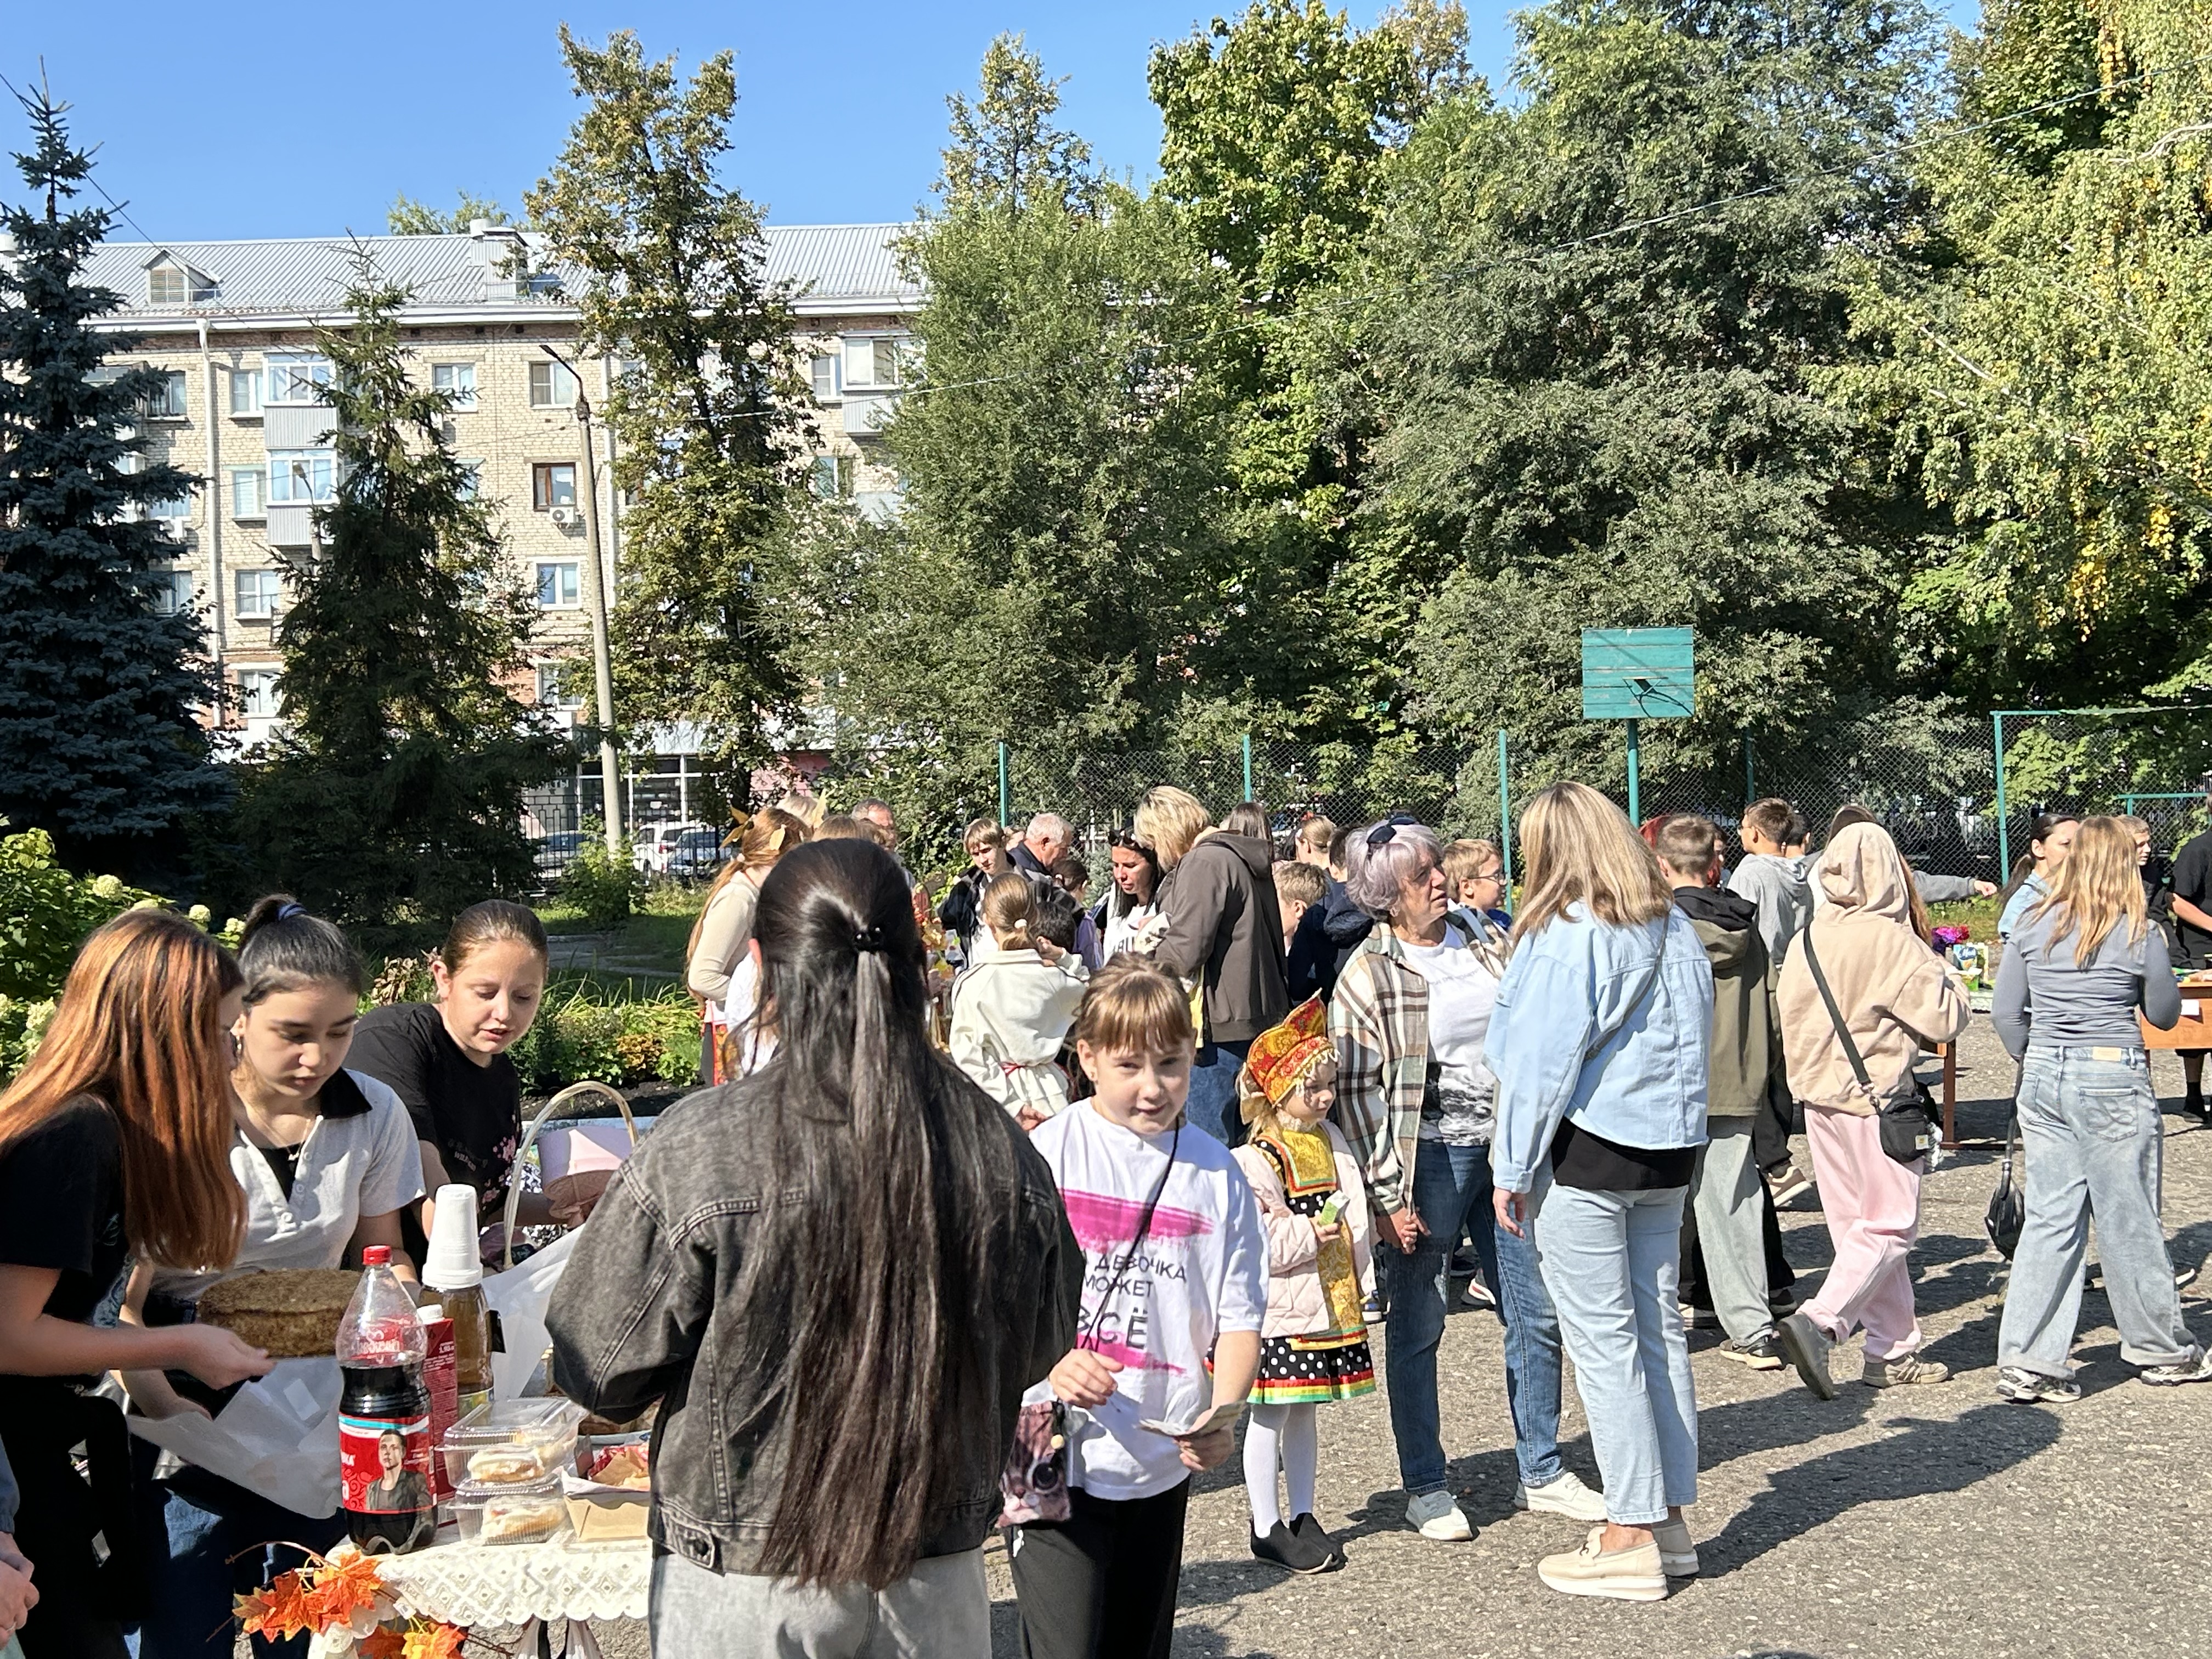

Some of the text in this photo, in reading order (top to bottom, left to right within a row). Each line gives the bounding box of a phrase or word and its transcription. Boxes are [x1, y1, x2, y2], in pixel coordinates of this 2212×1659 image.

[1094, 1254, 1187, 1283] ДЕВОЧКА
[1084, 1274, 1153, 1297] МОЖЕТ
[1077, 1305, 1148, 1350] ВСЁ
